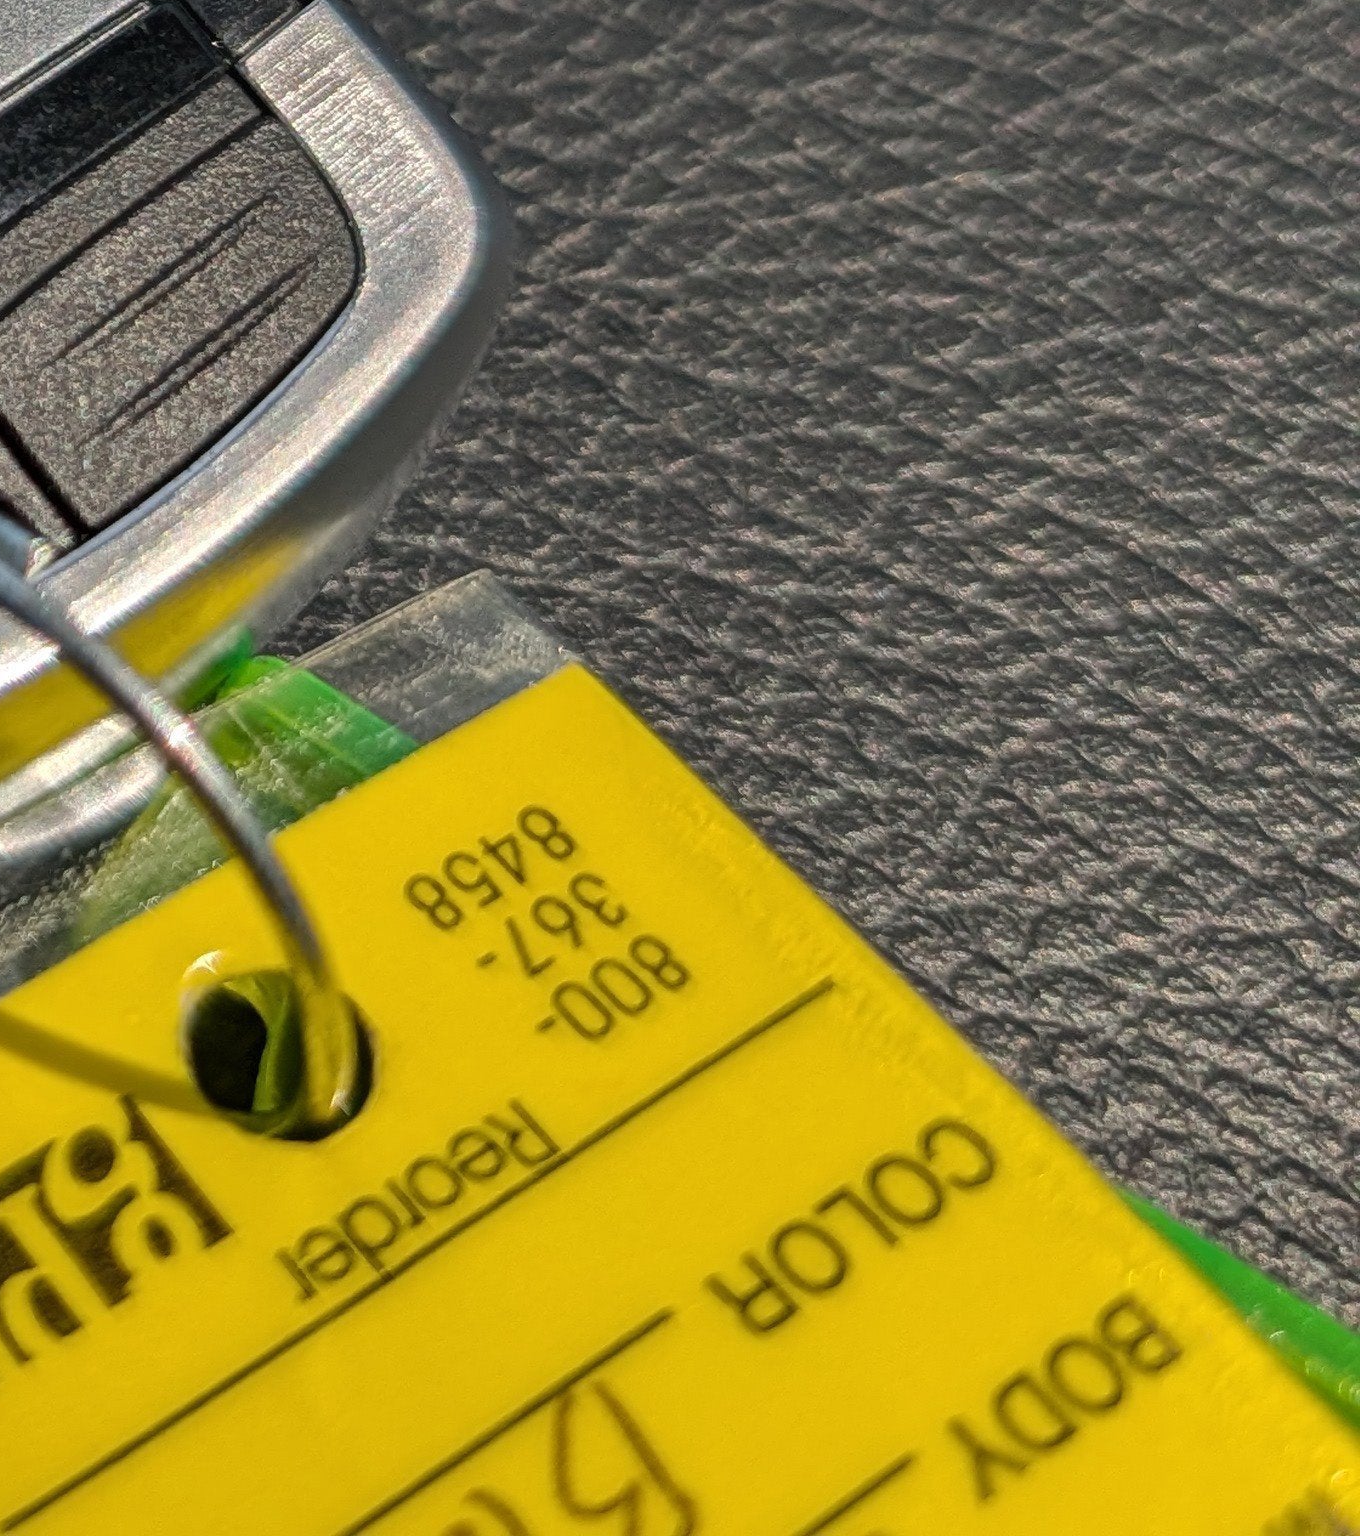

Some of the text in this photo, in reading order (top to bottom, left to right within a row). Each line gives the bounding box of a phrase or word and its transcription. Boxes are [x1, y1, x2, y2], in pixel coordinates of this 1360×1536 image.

[403, 804, 578, 931] 8458
[476, 872, 628, 978] 367-
[536, 934, 691, 1041] 800-
[275, 1098, 562, 1303] Reorder
[703, 1117, 998, 1337] COLOR
[946, 1290, 1184, 1503] BODY
